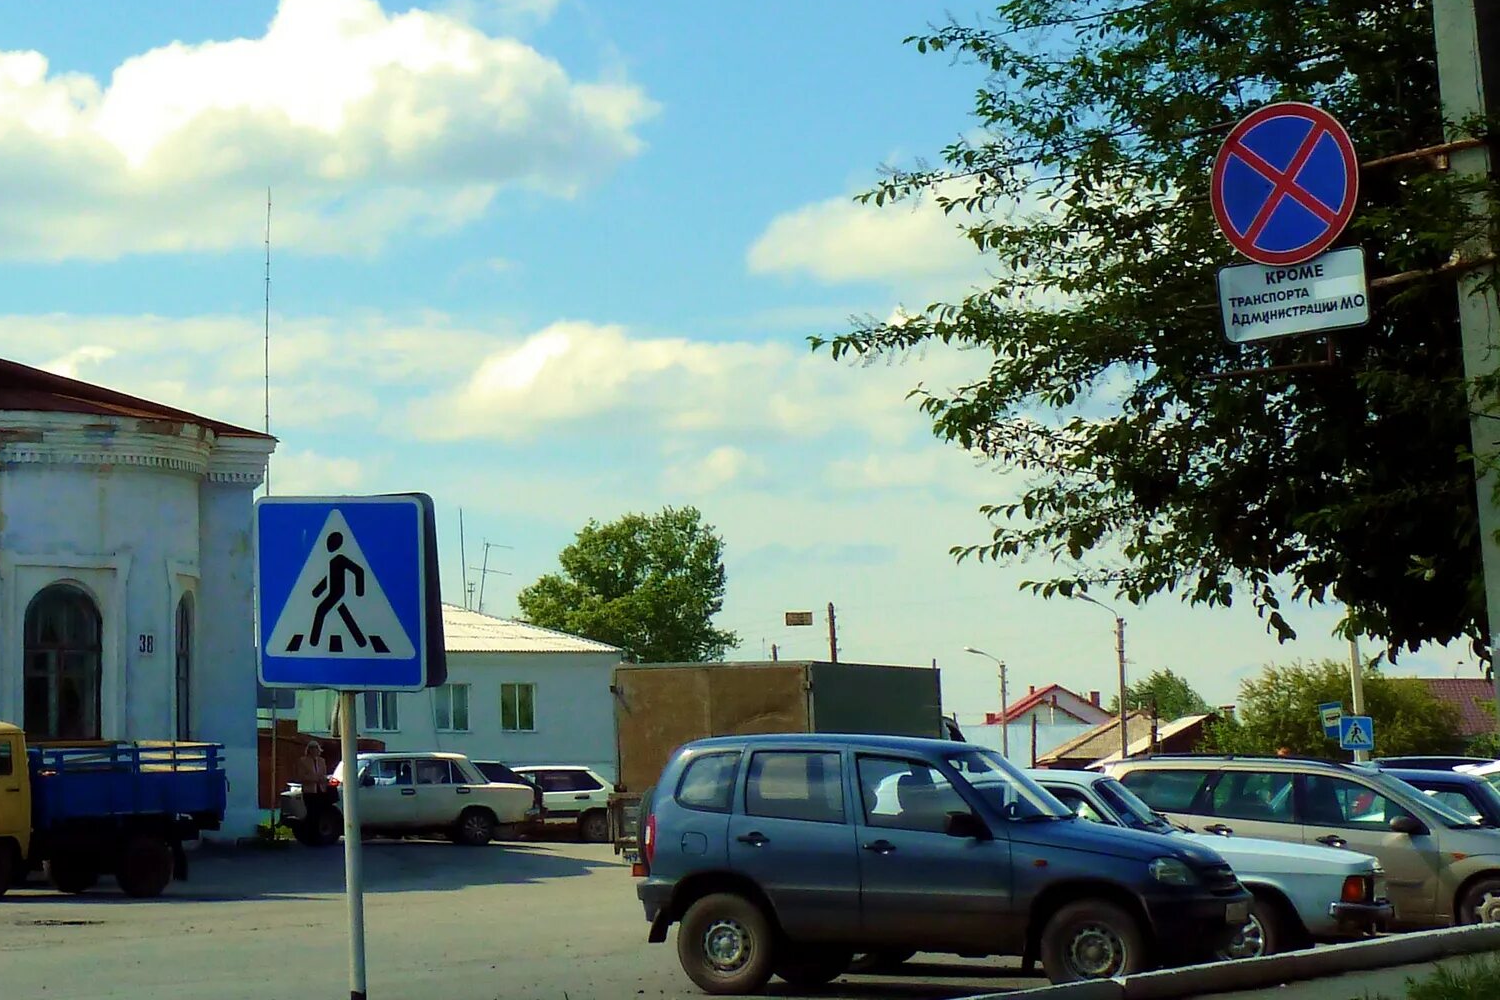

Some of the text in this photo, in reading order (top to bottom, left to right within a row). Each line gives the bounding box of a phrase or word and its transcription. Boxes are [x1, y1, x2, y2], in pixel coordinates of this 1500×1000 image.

[1265, 264, 1324, 285] КРОМЕ
[1228, 287, 1310, 308] ТРАНСПОРТА
[1340, 294, 1365, 311] МО
[139, 634, 153, 654] 38
